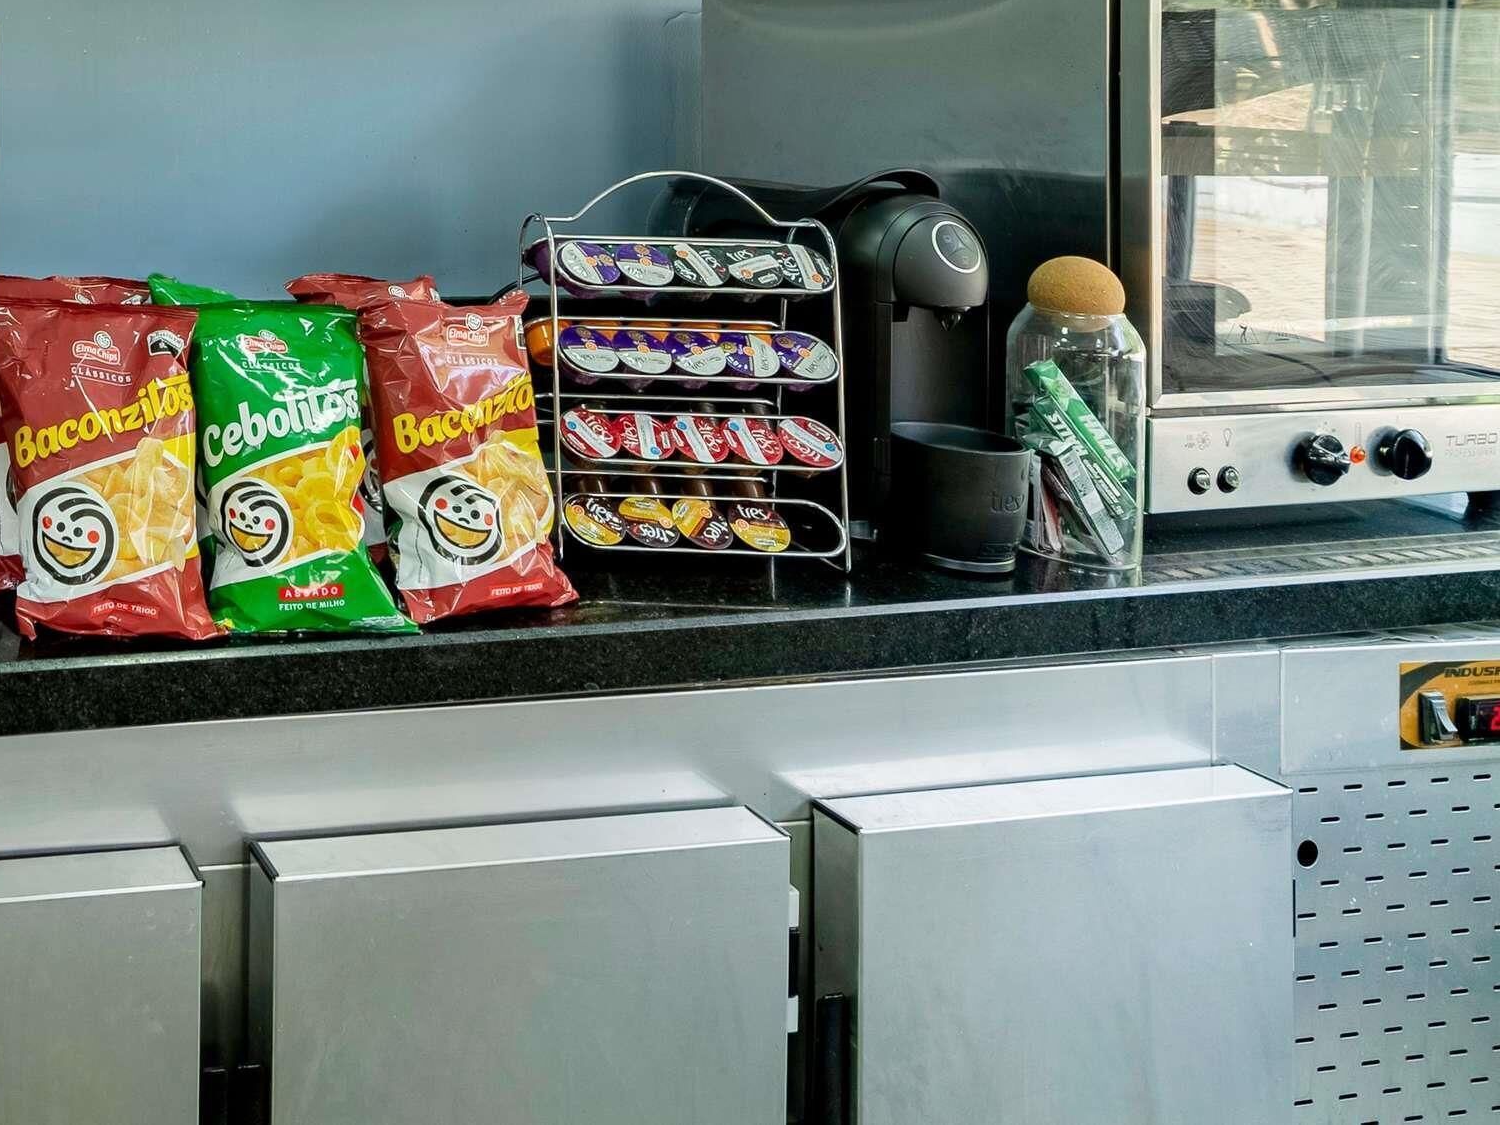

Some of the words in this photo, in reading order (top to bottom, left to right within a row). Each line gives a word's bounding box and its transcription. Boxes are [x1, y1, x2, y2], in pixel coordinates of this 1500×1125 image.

[446, 355, 499, 366] CLÁSSICOS
[70, 365, 132, 383] CLÁSSICOS
[14, 372, 195, 468] Baconzitos
[203, 378, 361, 467] Cebolitos
[1445, 432, 1498, 447] TURBO
[285, 586, 339, 598] ASSADO
[491, 587, 511, 596] FEITO
[93, 601, 115, 614] FEITO
[116, 601, 129, 610] DE
[131, 604, 157, 616] TRIGO
[278, 603, 304, 611] FEITO
[306, 602, 317, 610] DE
[319, 599, 346, 609] MILHO
